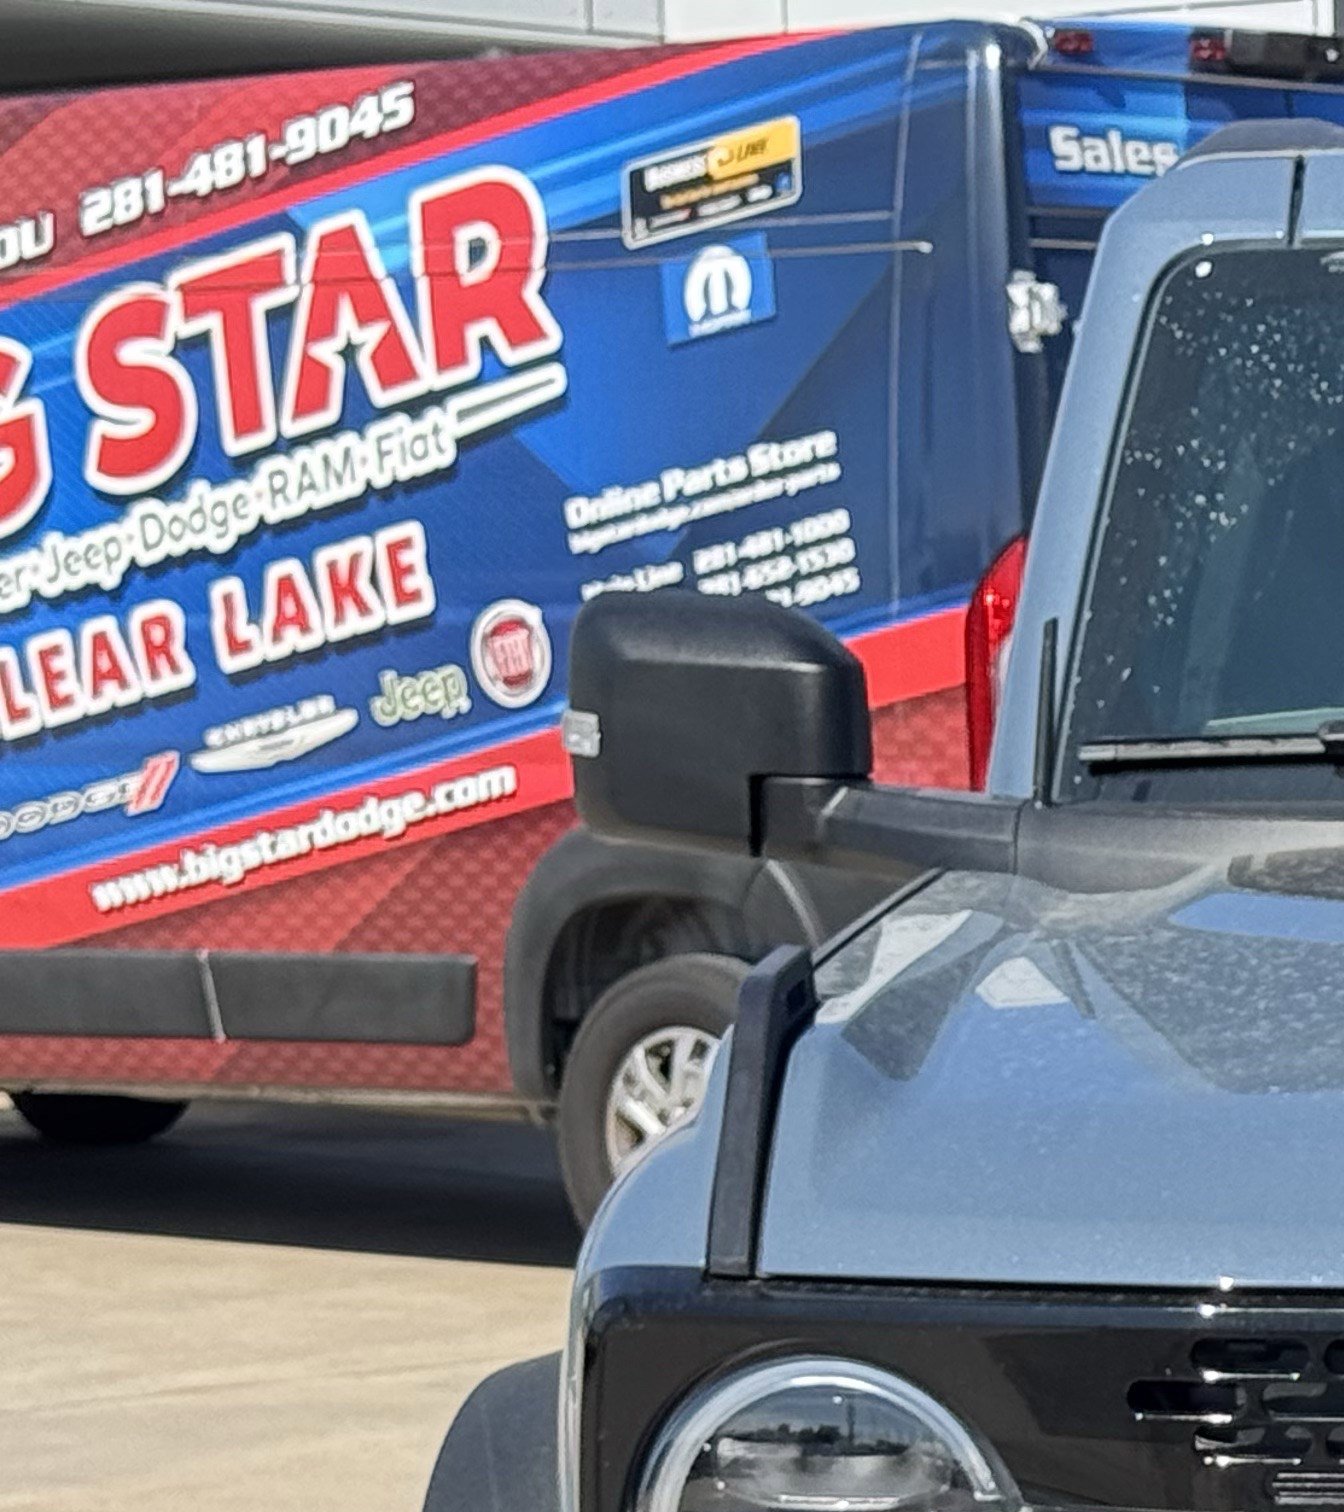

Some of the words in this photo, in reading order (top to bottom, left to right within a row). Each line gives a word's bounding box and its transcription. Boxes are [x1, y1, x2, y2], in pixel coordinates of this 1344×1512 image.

[80, 81, 415, 237] 281-481-9045
[1049, 125, 1178, 177] Sales
[80, 170, 557, 488] STAR
[46, 535, 123, 585] Jeep
[139, 492, 251, 552] Dodge
[267, 445, 357, 511] RAM
[374, 423, 447, 475] Fiat
[215, 527, 431, 667] LAKE
[370, 665, 472, 727] Jeep
[90, 767, 517, 911] www.bigstardodge.com
